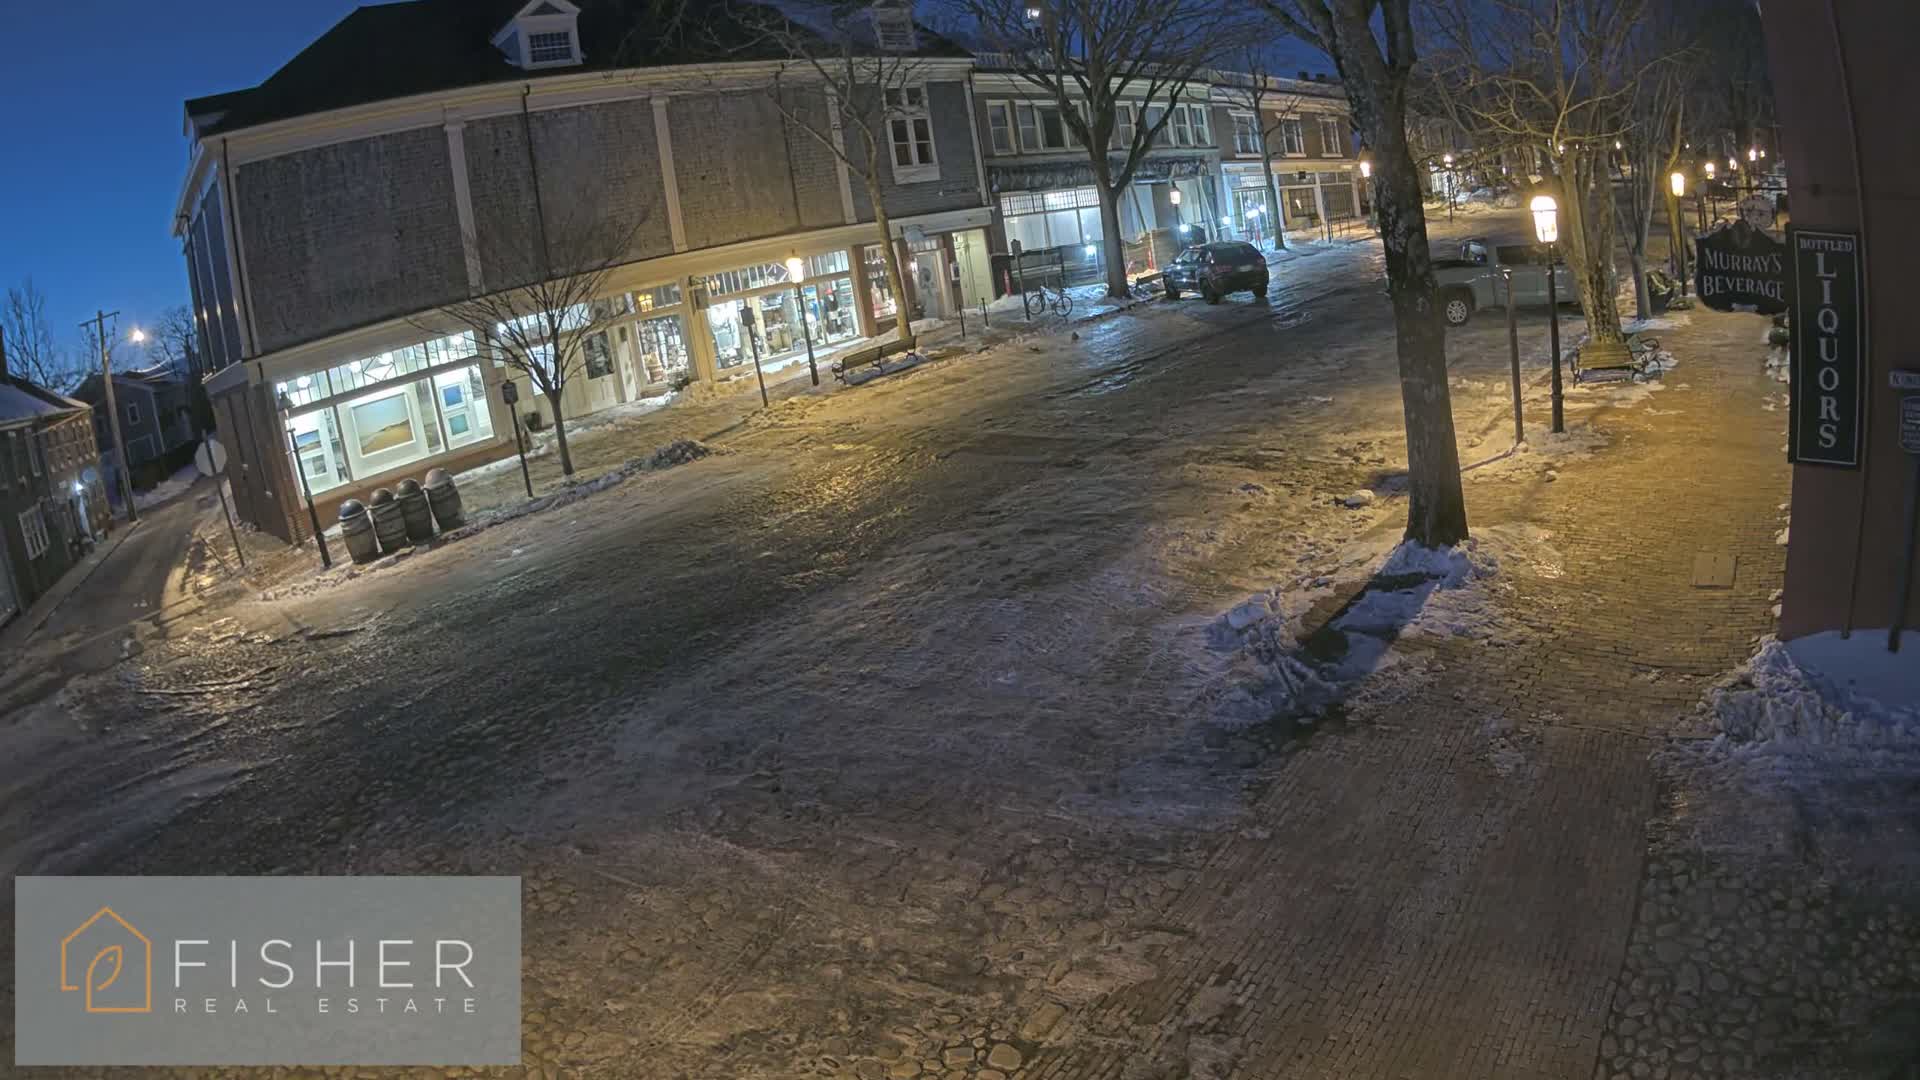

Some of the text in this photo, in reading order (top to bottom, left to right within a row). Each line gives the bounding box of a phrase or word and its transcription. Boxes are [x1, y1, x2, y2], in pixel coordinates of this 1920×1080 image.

[1800, 238, 1853, 252] BOTTLED
[1705, 248, 1782, 273] MURRAY'S
[1703, 275, 1785, 300] BEVERAGE
[1816, 252, 1841, 448] LIQUORS
